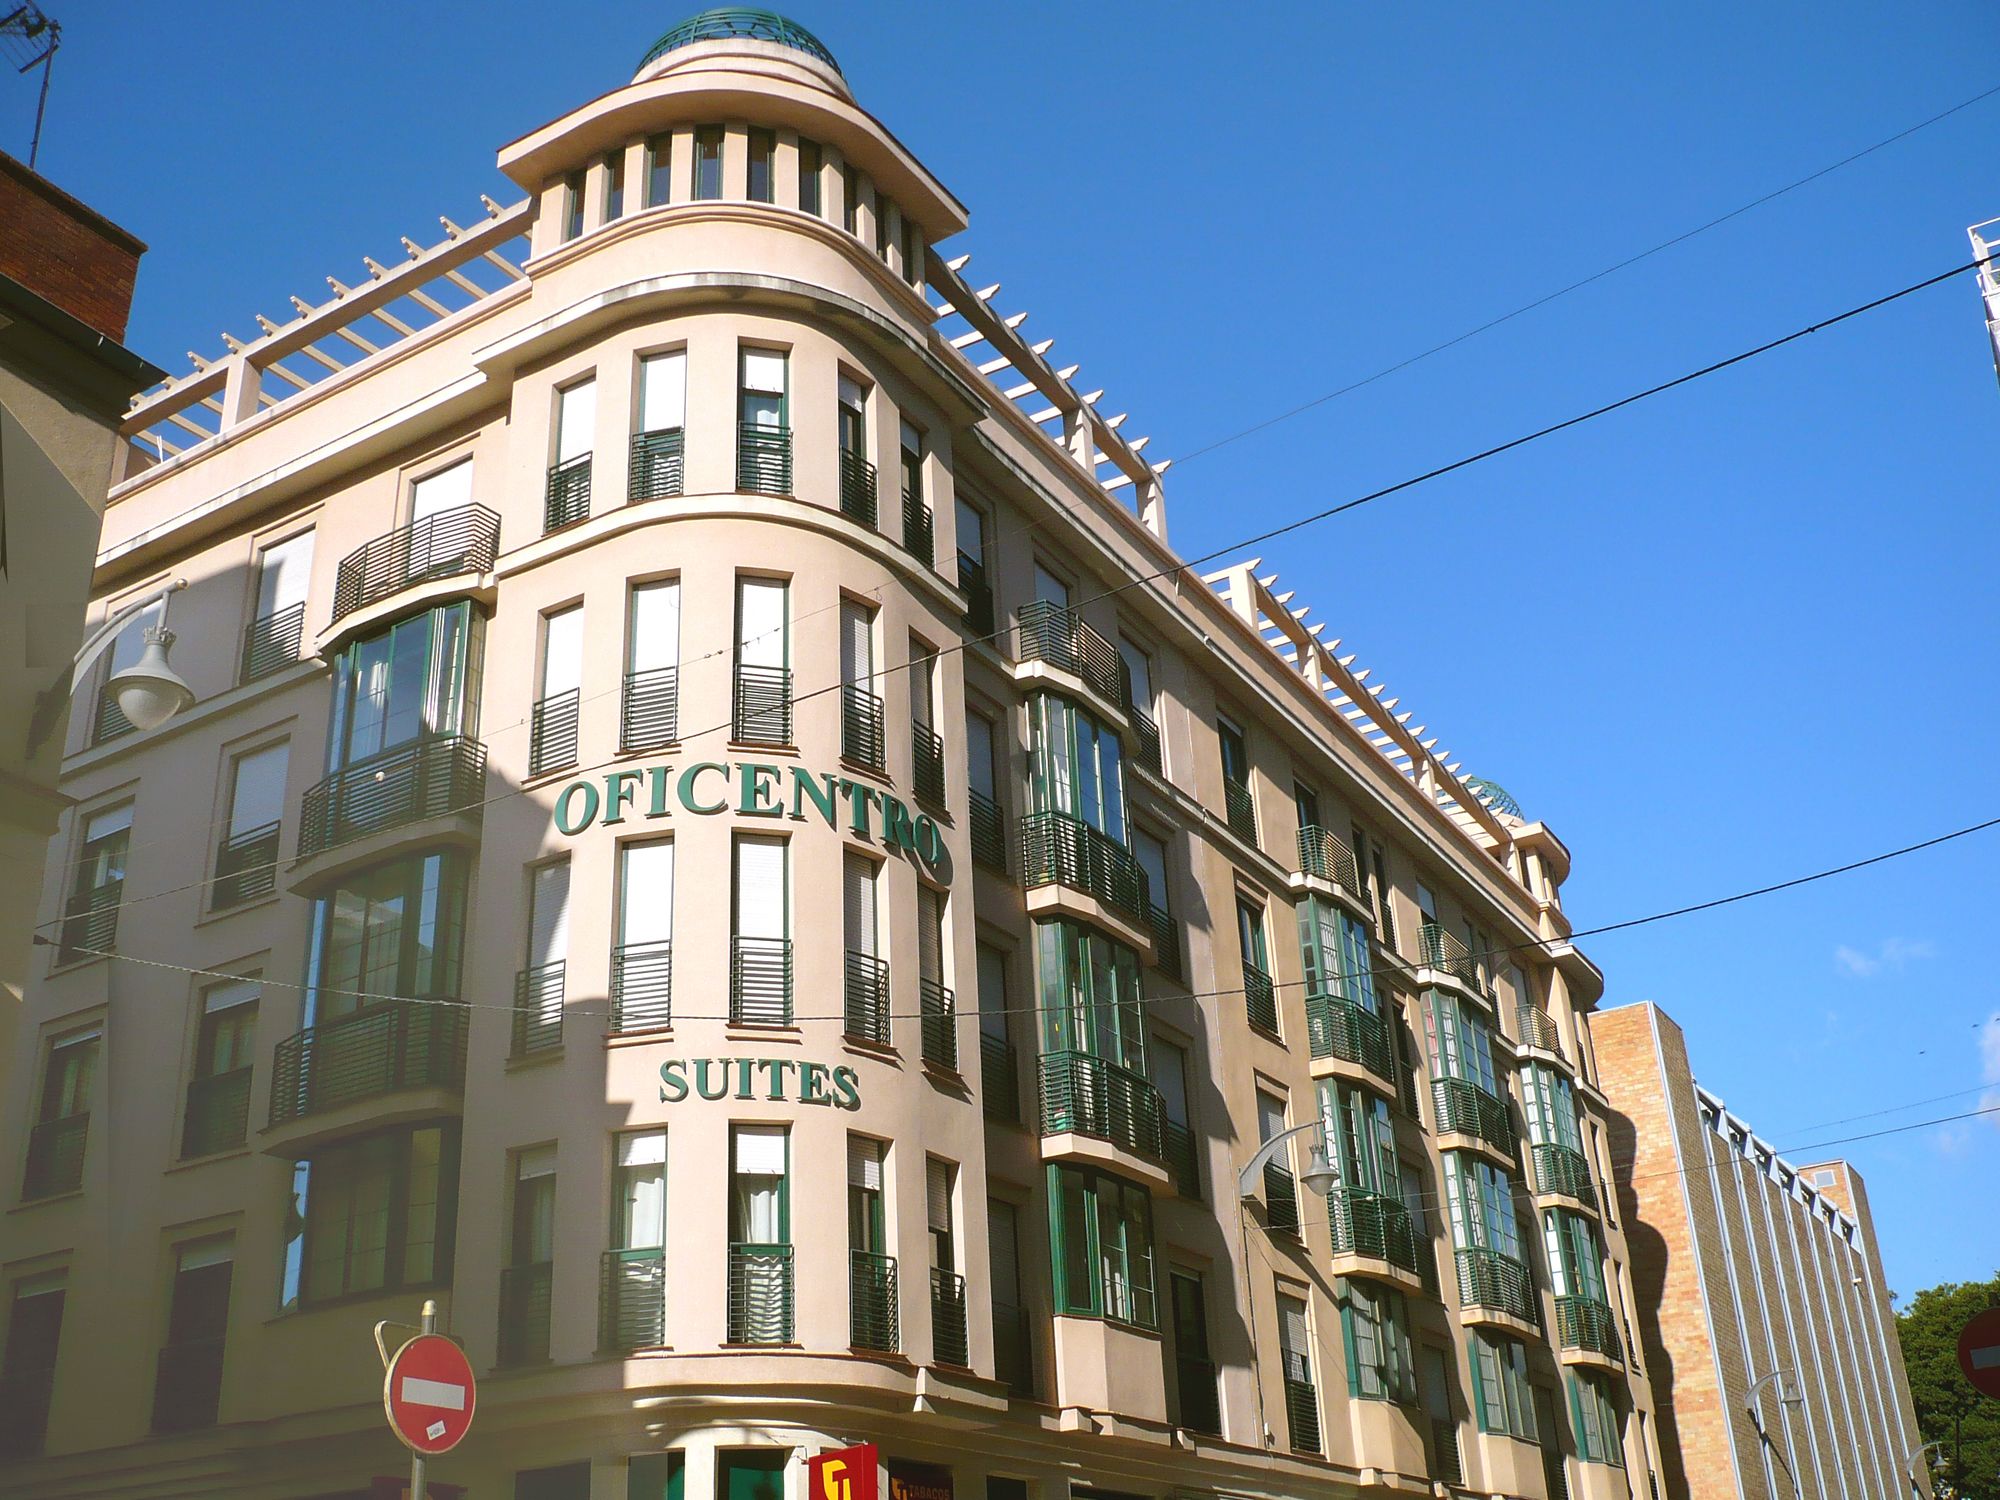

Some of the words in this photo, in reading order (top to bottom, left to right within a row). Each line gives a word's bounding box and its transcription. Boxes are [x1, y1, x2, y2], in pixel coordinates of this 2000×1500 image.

[554, 762, 943, 864] OFICENTRO
[659, 1058, 859, 1107] SUITES
[908, 1485, 950, 1500] TABACOS
